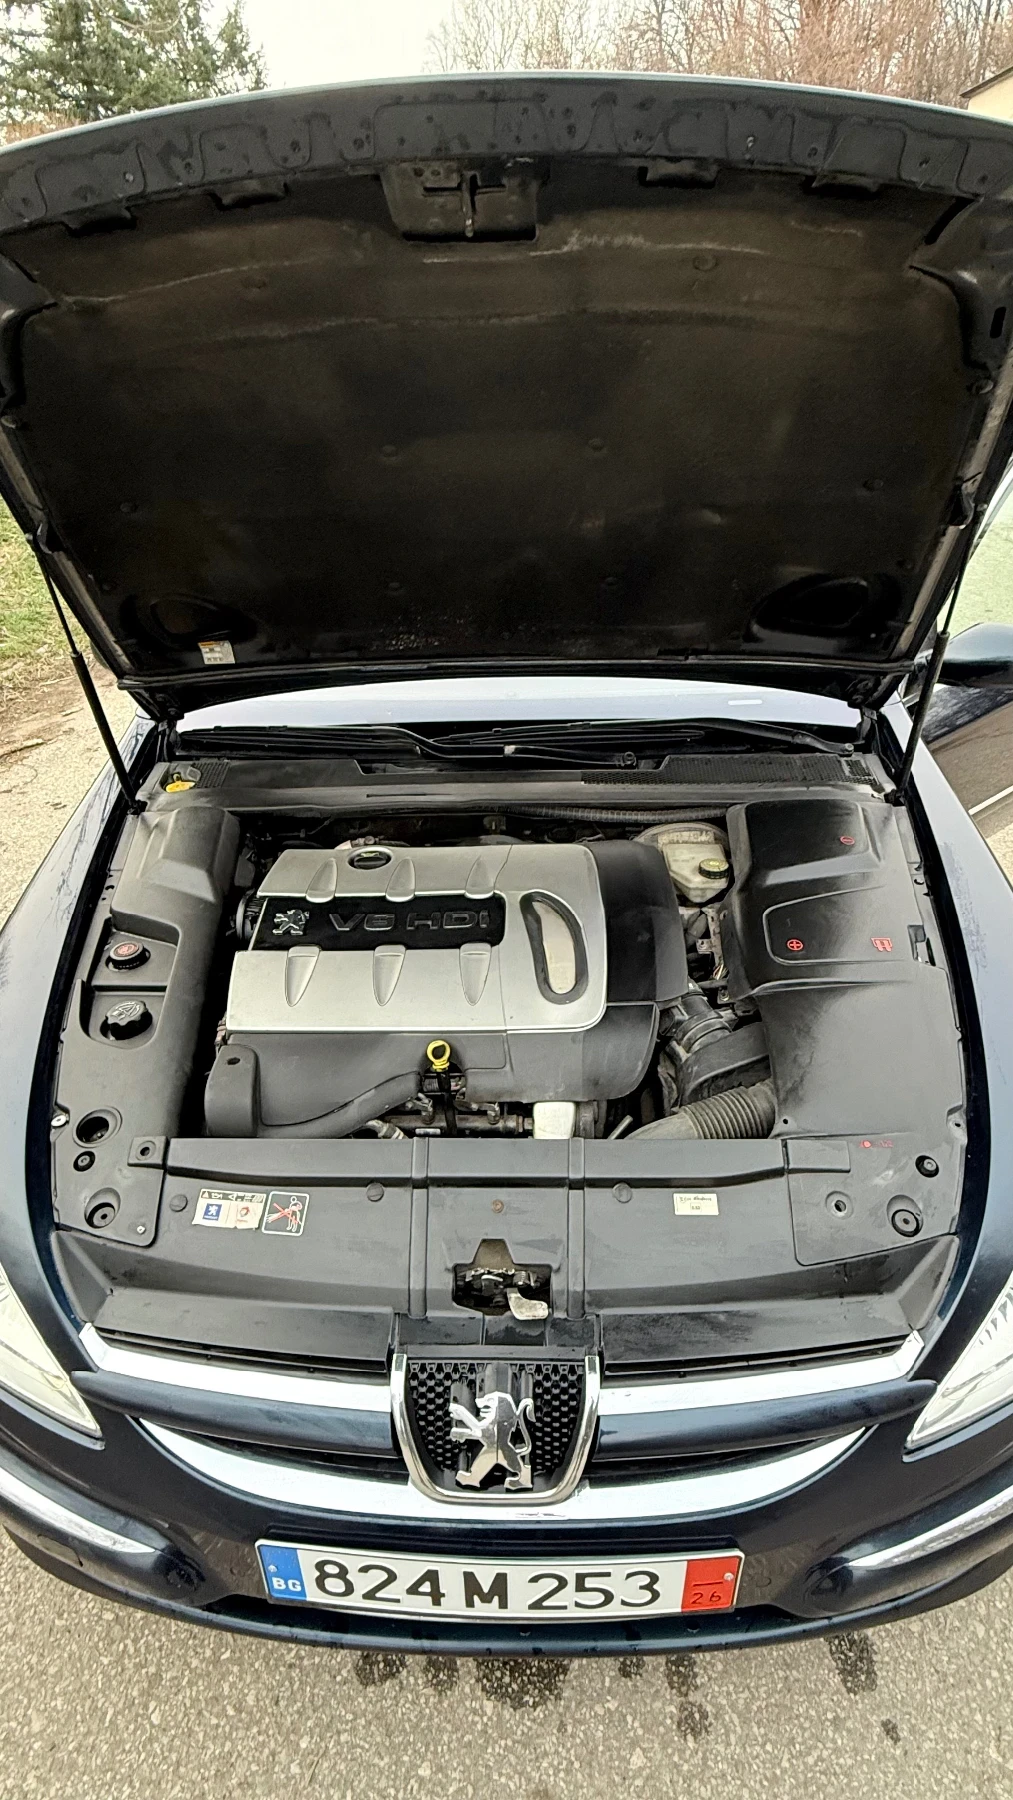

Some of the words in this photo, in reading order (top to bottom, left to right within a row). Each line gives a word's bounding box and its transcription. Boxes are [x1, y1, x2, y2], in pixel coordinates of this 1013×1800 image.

[329, 912, 395, 931] V6
[271, 1577, 301, 1592] BG
[314, 1559, 446, 1607] 824
[462, 1571, 509, 1610] M
[527, 1570, 661, 1610] 253
[690, 1590, 722, 1605] 26
